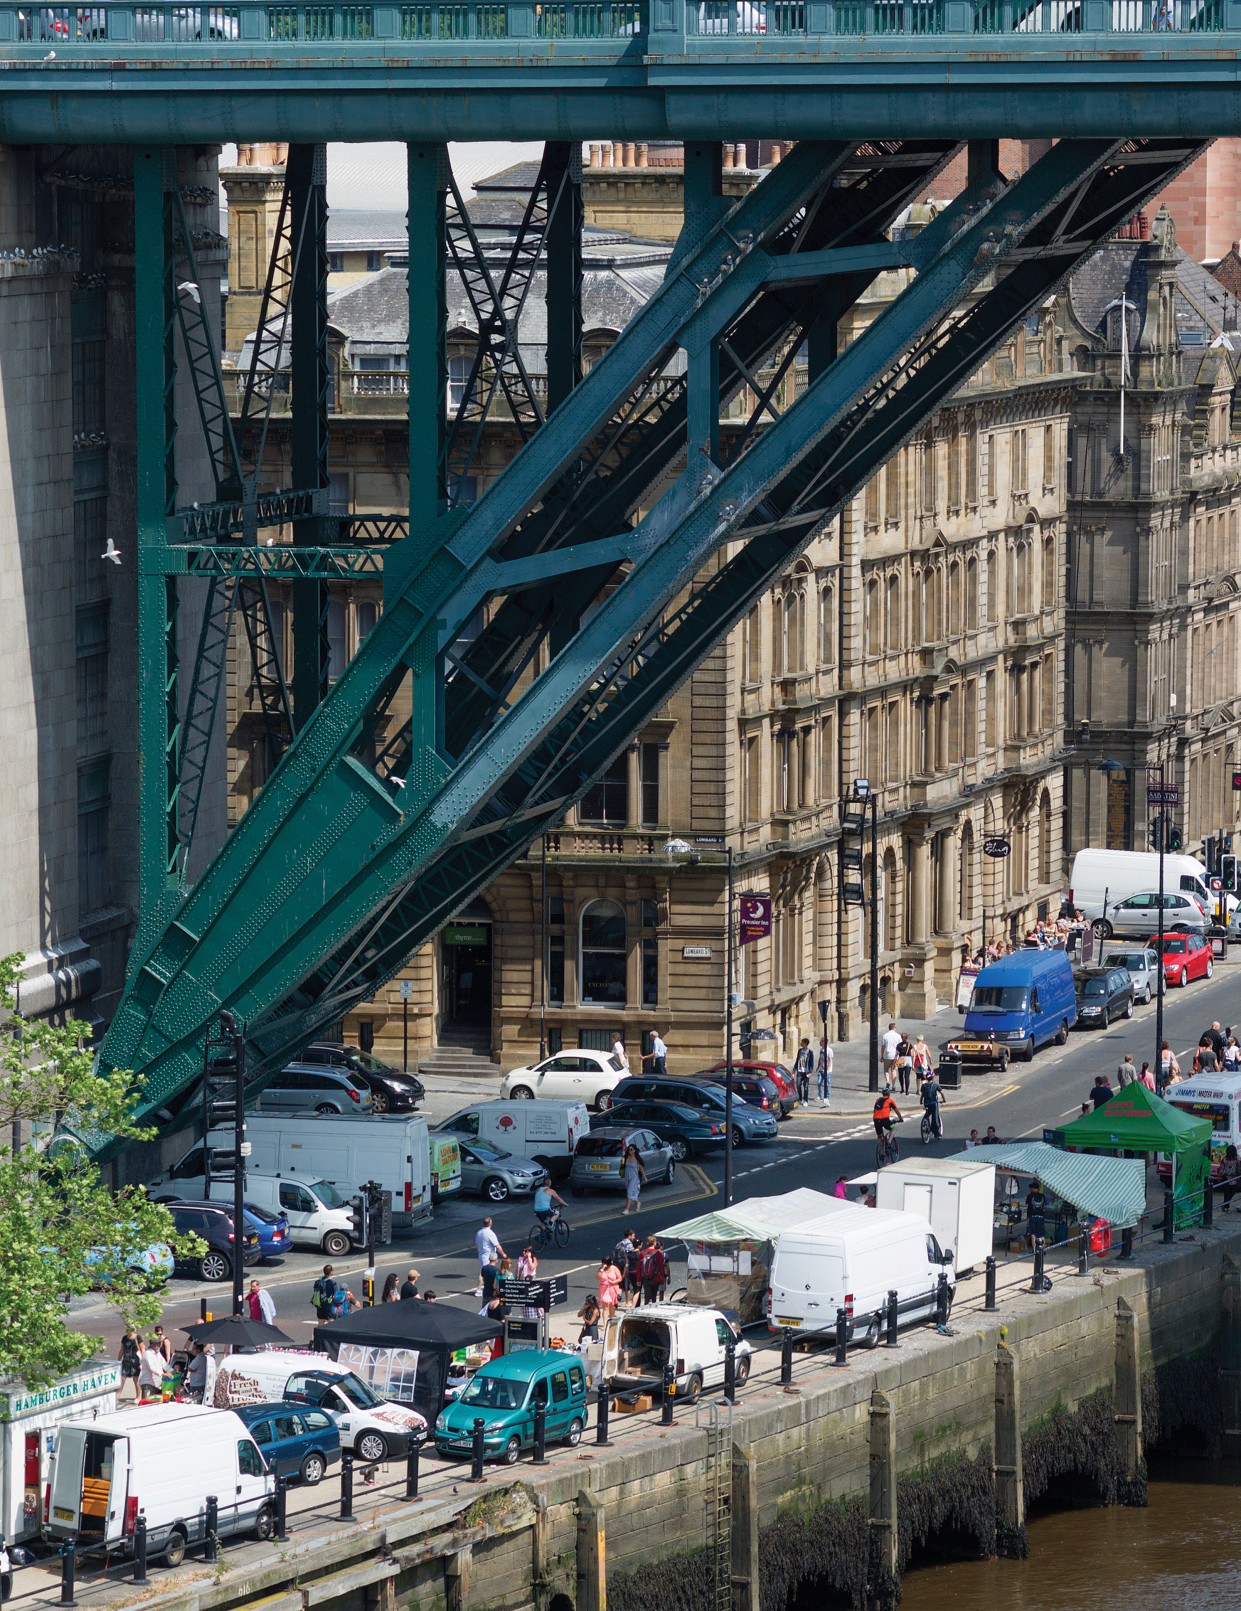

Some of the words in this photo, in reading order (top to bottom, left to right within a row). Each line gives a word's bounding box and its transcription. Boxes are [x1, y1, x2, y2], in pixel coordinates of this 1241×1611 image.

[1148, 791, 1178, 800] SABTINI
[985, 842, 1009, 856] Slug
[233, 1379, 259, 1389] Fresh
[15, 1383, 79, 1411] HAMBURGER
[82, 1371, 118, 1391] HAVEN
